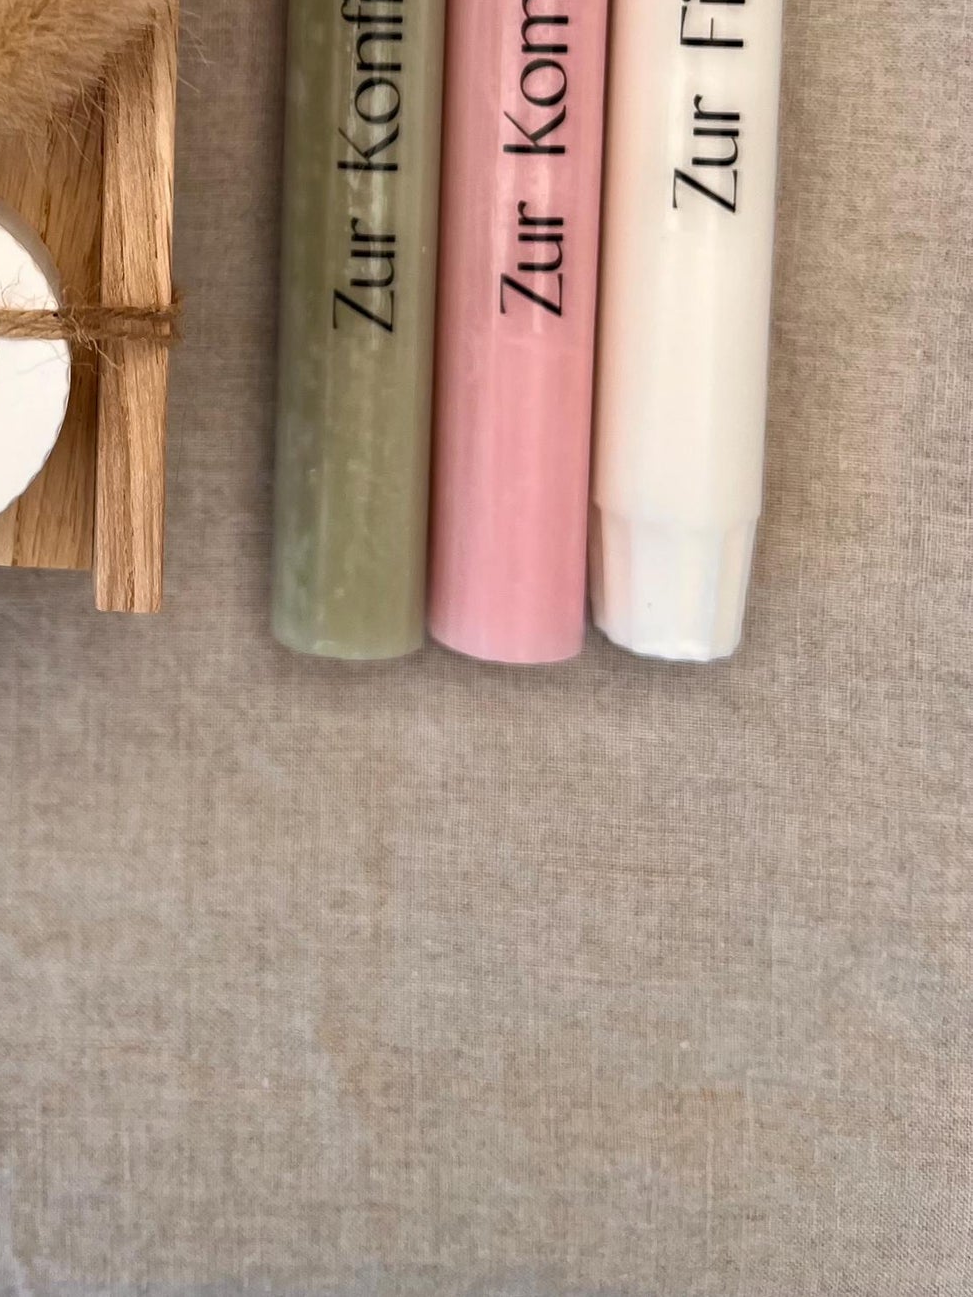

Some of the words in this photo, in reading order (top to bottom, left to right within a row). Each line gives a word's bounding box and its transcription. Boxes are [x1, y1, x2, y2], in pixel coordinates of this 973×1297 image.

[673, 94, 740, 214] Zur
[332, 217, 397, 334] Zur
[500, 201, 564, 318] Zur
